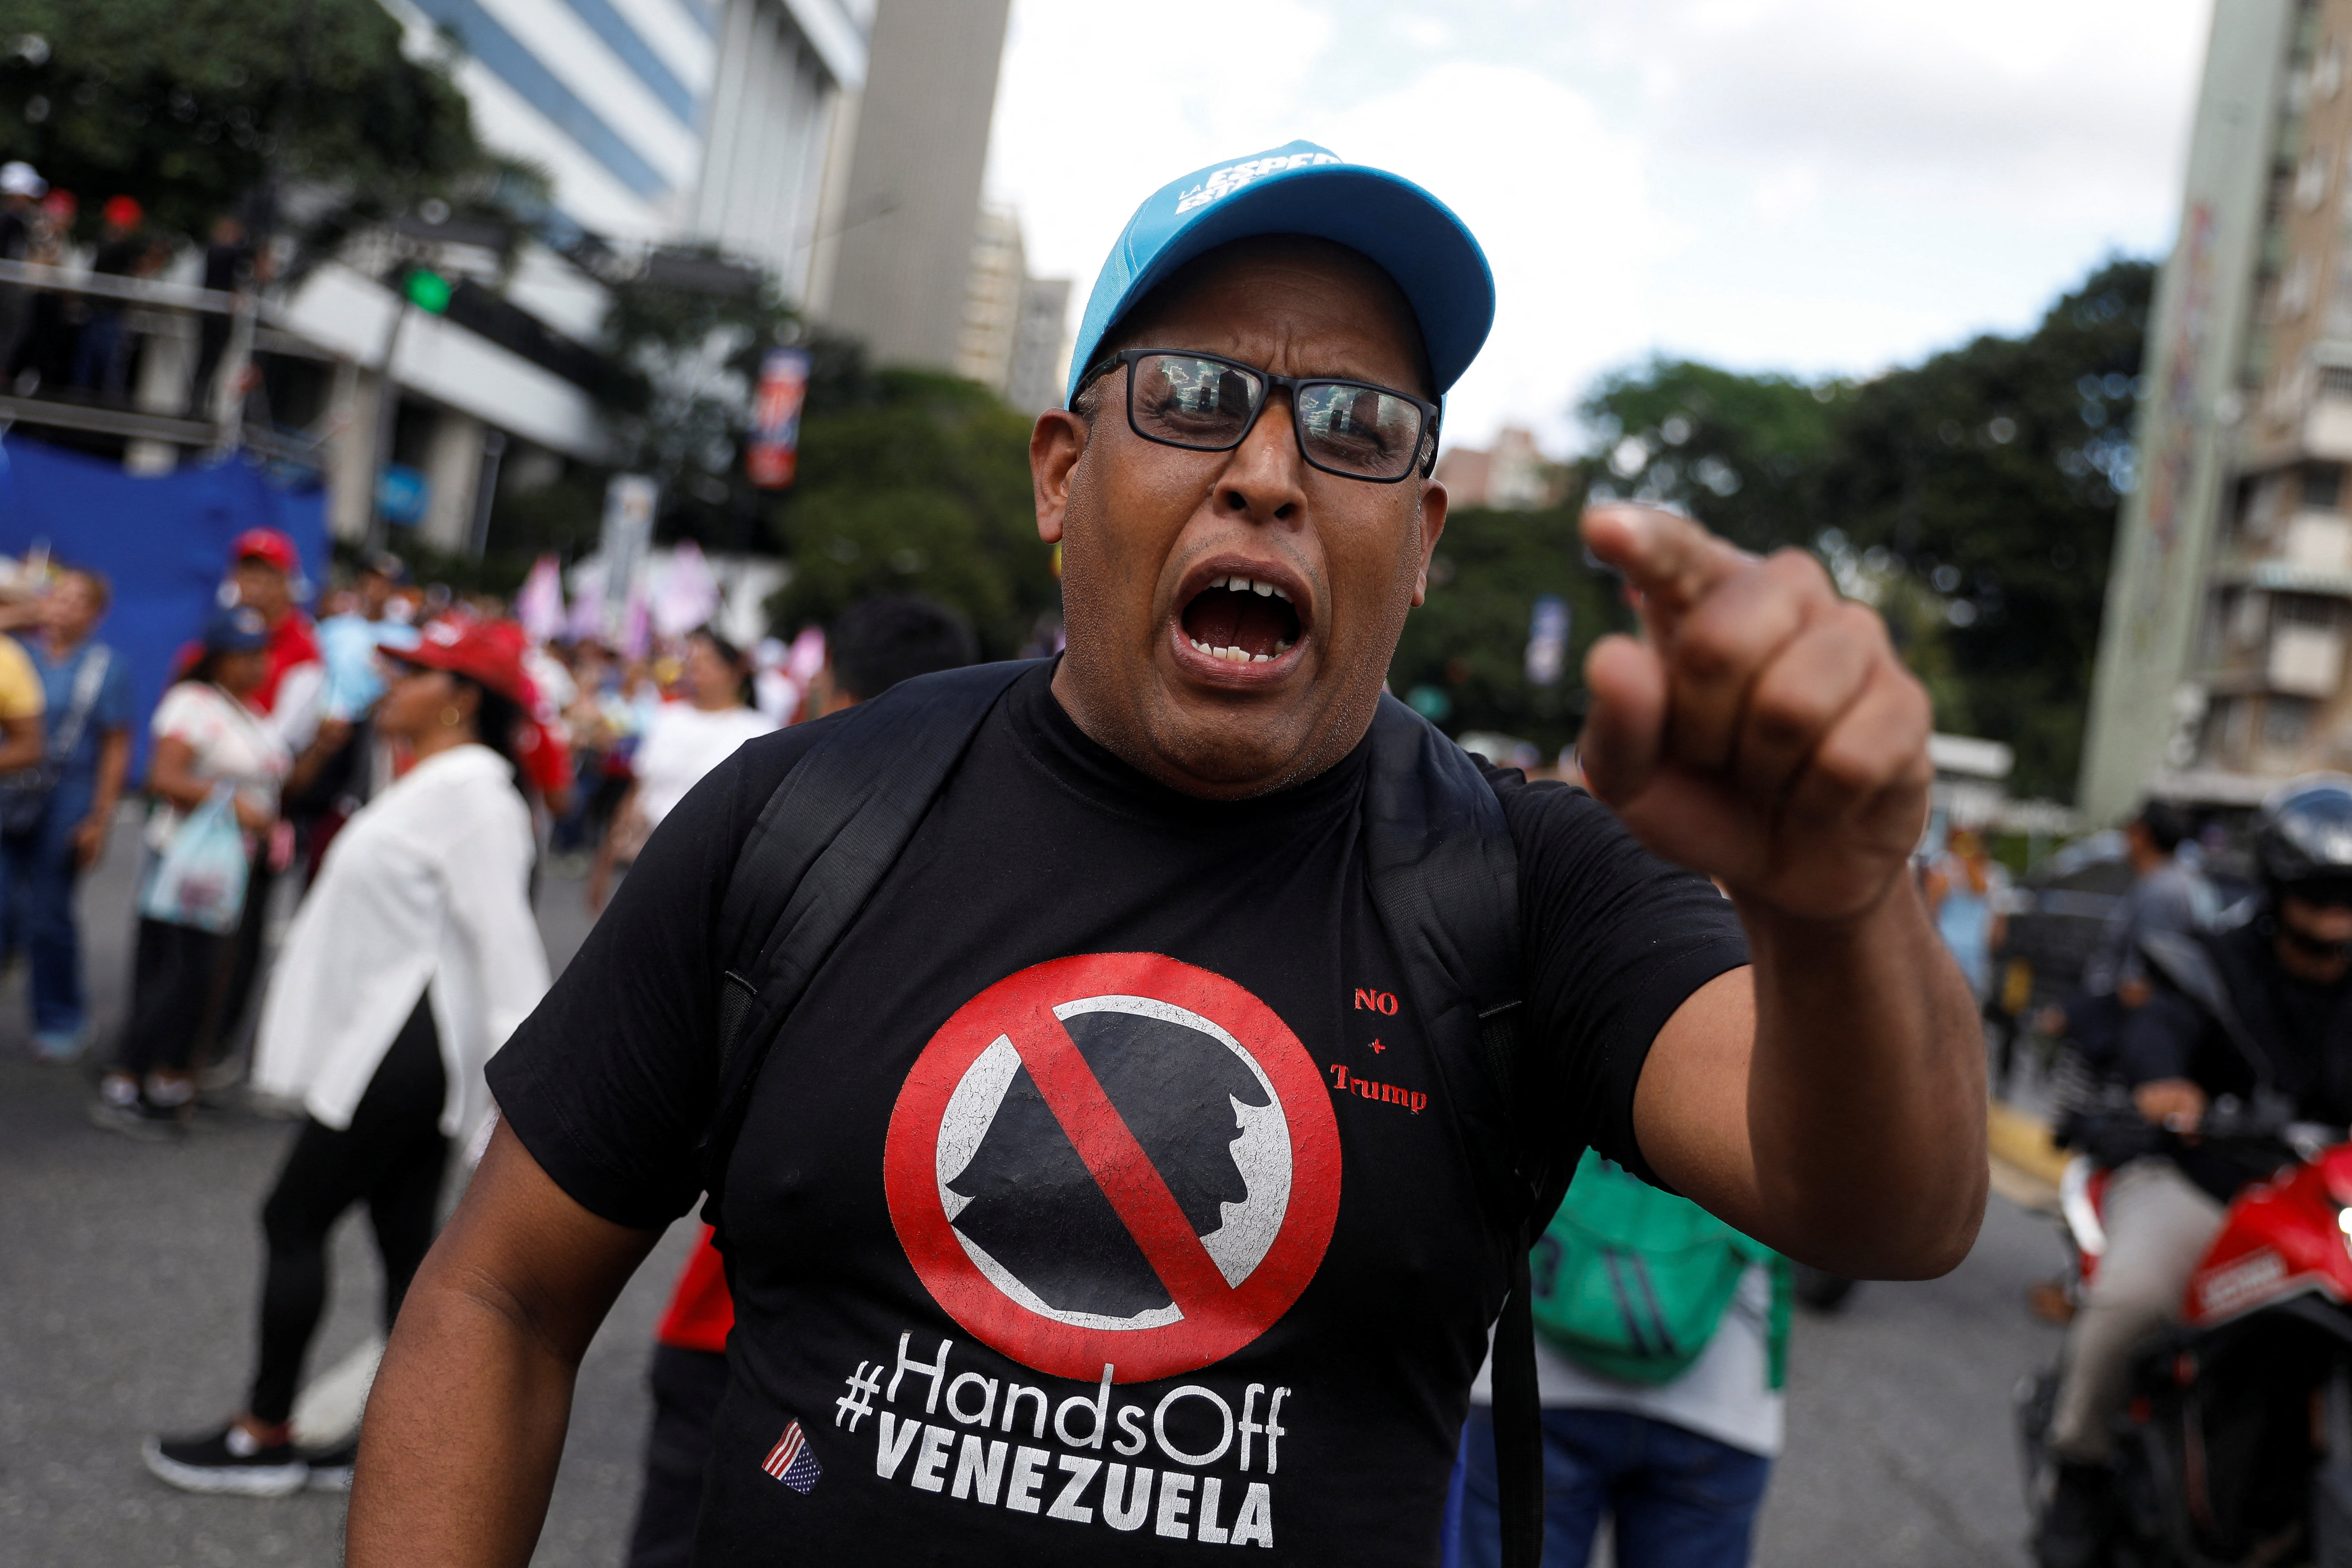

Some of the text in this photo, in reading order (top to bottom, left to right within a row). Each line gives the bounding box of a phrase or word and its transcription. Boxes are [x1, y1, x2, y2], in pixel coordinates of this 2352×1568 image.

[1178, 184, 1202, 200] LA
[1354, 987, 1399, 1016] NO
[1330, 1063, 1428, 1115] Trump
[877, 1410, 1274, 1548] VENEZUELA
